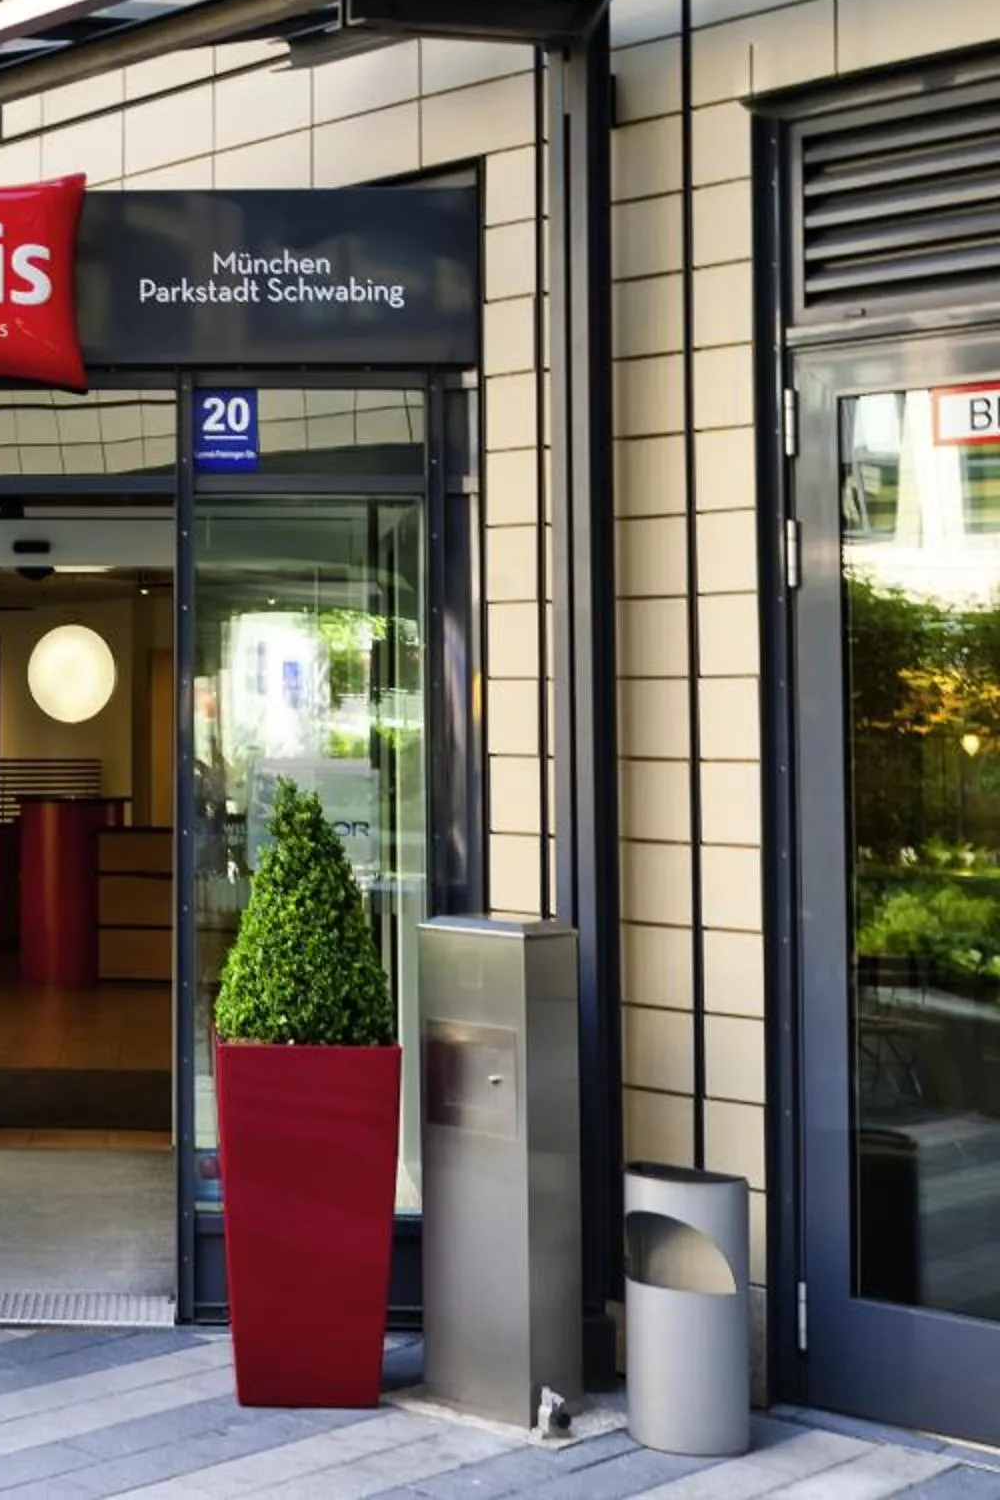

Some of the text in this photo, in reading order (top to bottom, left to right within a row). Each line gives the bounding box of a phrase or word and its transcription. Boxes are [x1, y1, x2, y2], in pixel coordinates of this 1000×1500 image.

[213, 249, 331, 274] München
[139, 276, 405, 308] Parkstadt Schwabing
[202, 396, 250, 432] 20
